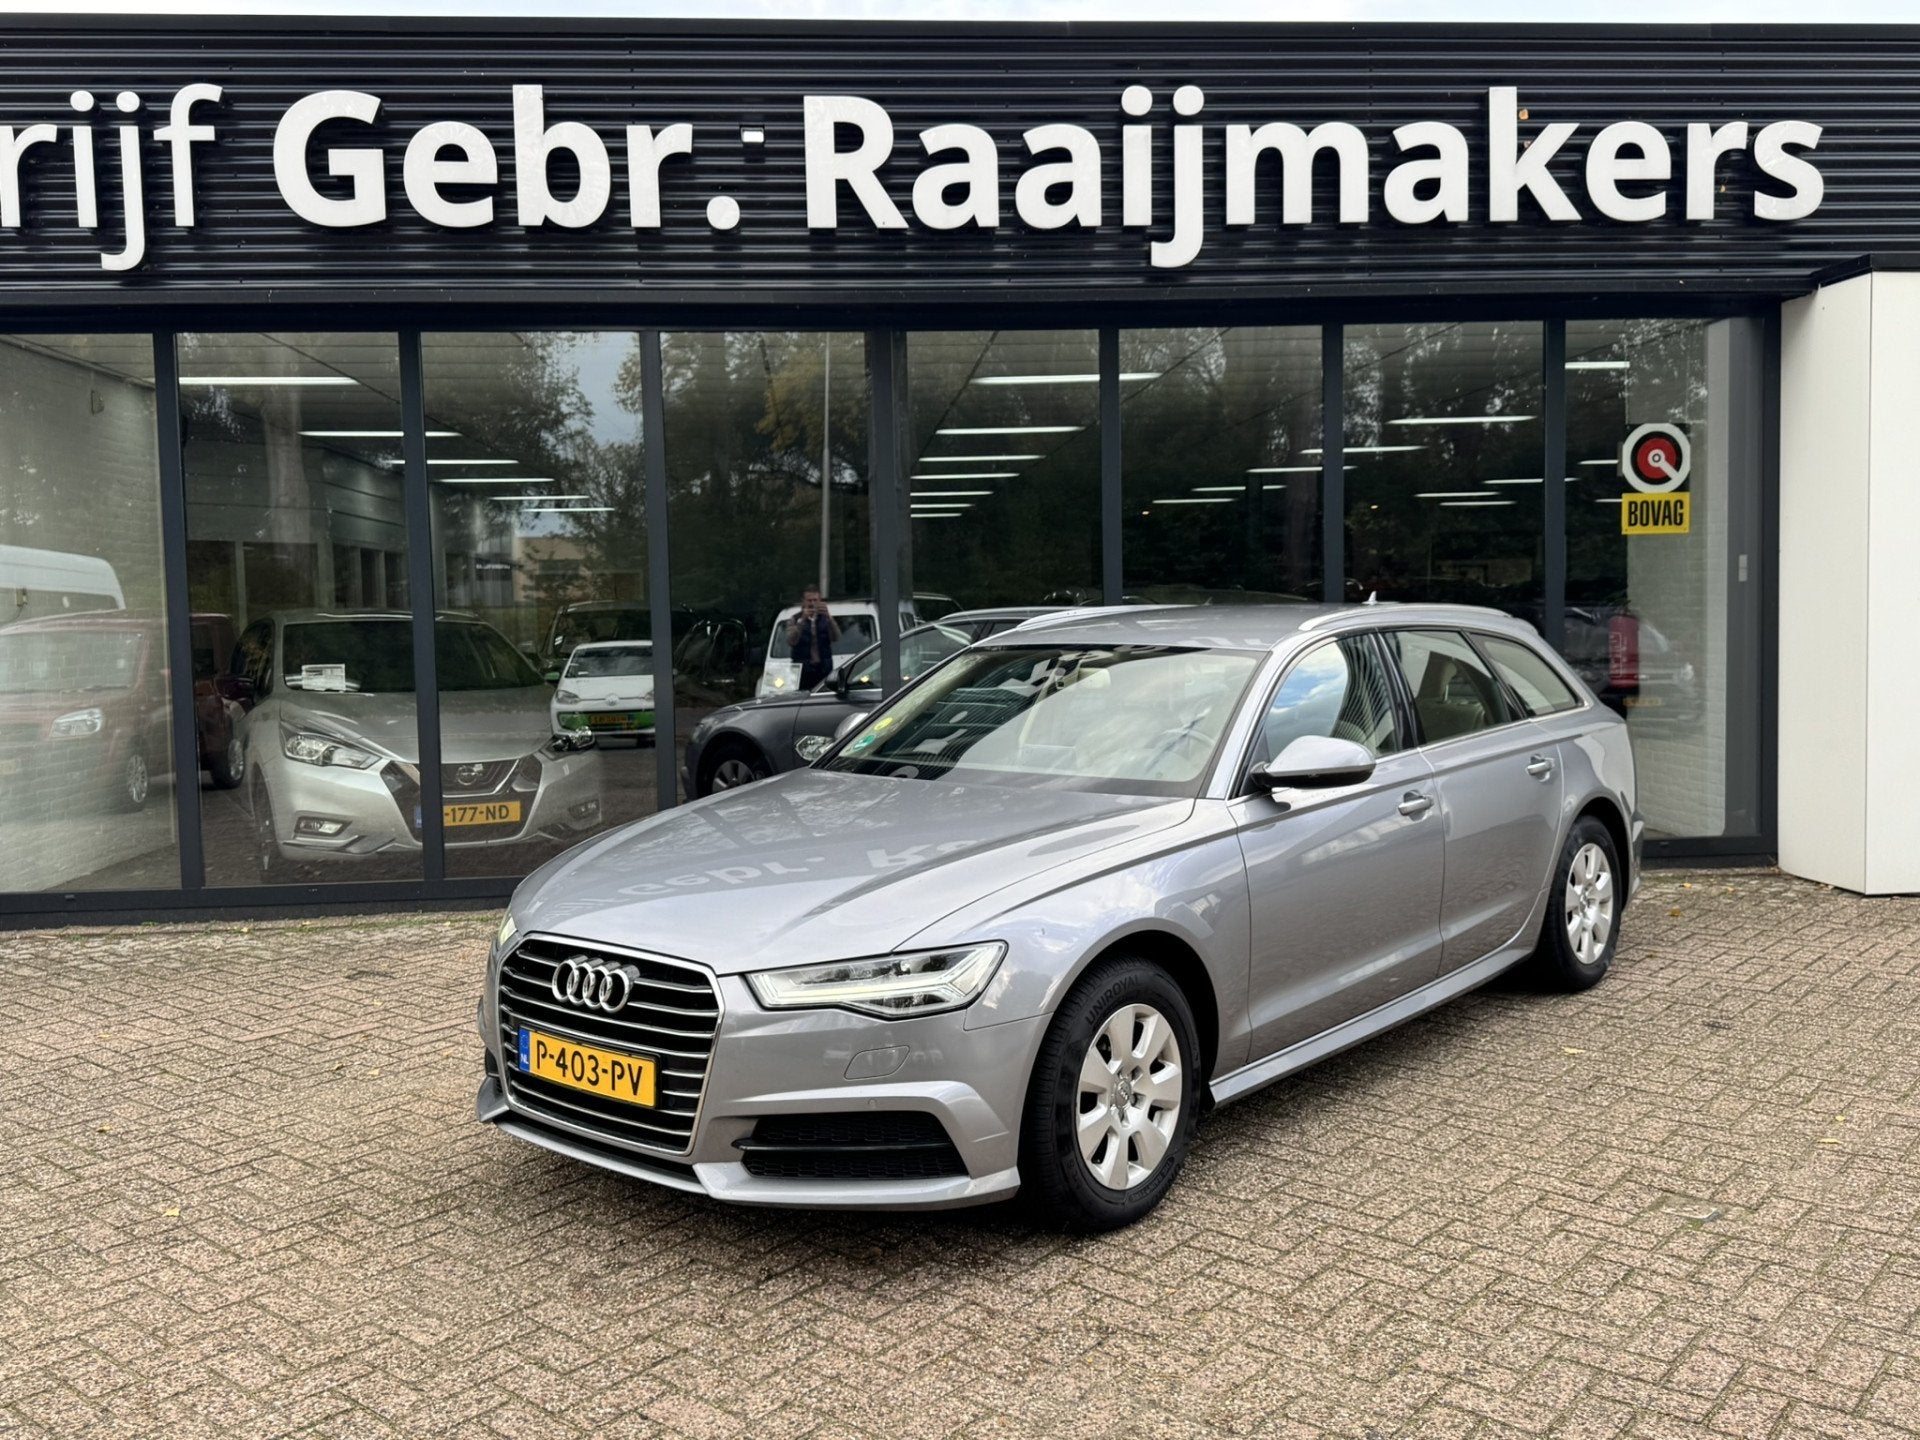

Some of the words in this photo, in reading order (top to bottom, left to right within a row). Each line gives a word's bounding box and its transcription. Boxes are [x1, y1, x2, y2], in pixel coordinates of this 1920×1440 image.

[0, 83, 223, 270] rijf
[272, 84, 741, 229] Gebr.
[803, 85, 1825, 268] Raaijmakers
[1627, 499, 1684, 527] BOVAG
[444, 804, 510, 823] -177-ND
[1085, 974, 1140, 1025] UNIROYAL
[536, 1039, 643, 1096] P-403-PV
